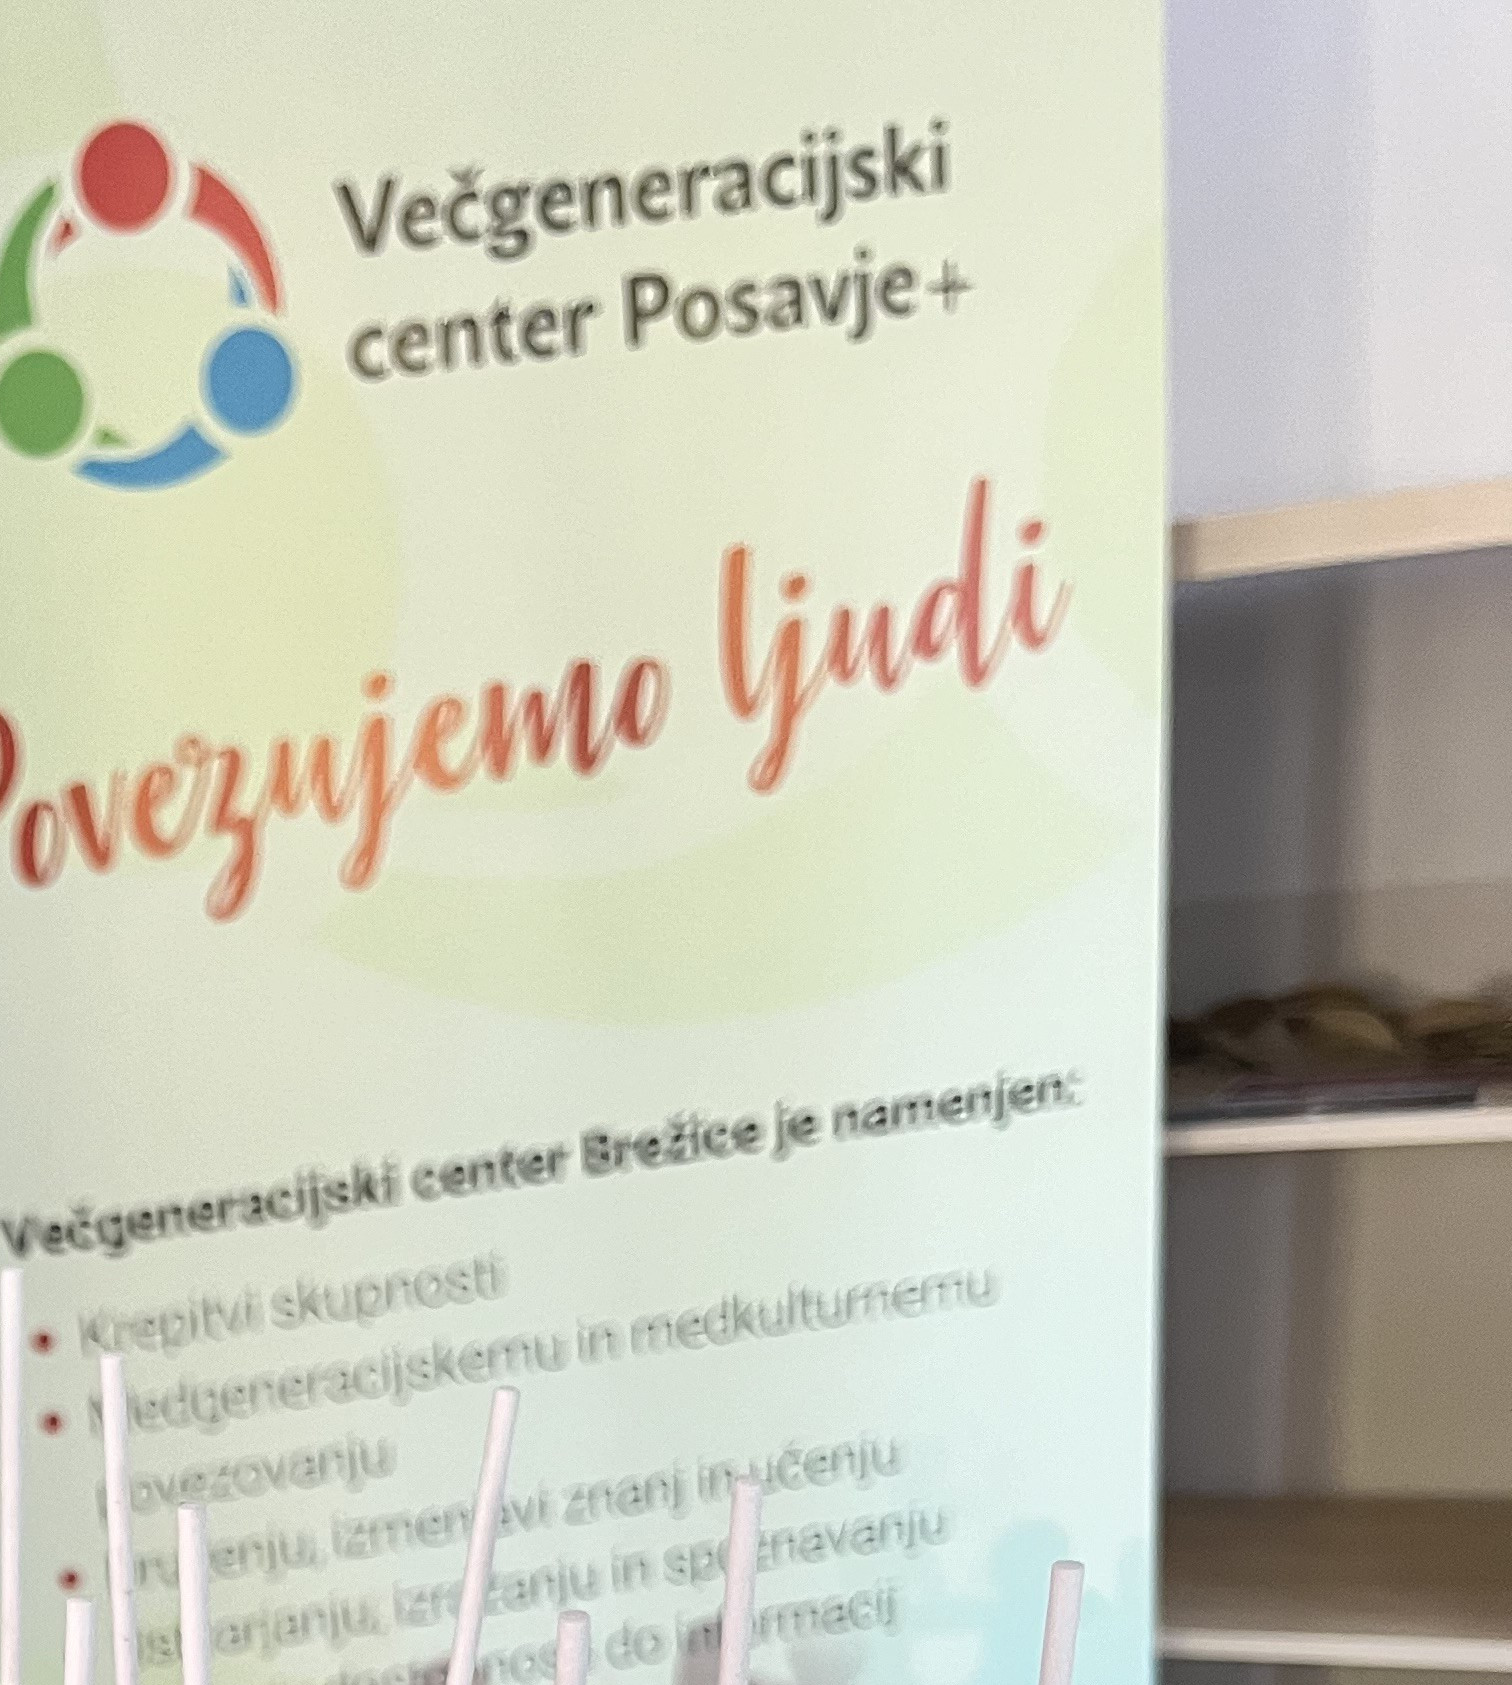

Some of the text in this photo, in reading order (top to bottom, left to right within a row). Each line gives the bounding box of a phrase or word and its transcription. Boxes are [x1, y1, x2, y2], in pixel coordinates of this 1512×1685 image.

[334, 116, 953, 261] Večgeneracijski
[345, 296, 601, 383] center
[719, 475, 1072, 794] ljudi
[410, 1141, 567, 1201] center
[580, 1110, 764, 1178] Brežice
[769, 1098, 822, 1162] je
[831, 1068, 1085, 1141] namenjen:
[79, 1249, 509, 1357] Krepitvi skupnosti
[577, 1316, 629, 1364] in
[632, 1266, 1000, 1354] medkulturnemu
[106, 1433, 904, 1588] ruenju, izmenvi znanj in učenju
[128, 1592, 383, 1668] starjanju,
[611, 1542, 653, 1593] in
[605, 1618, 672, 1671] do
[675, 1578, 902, 1654] inrmacij
